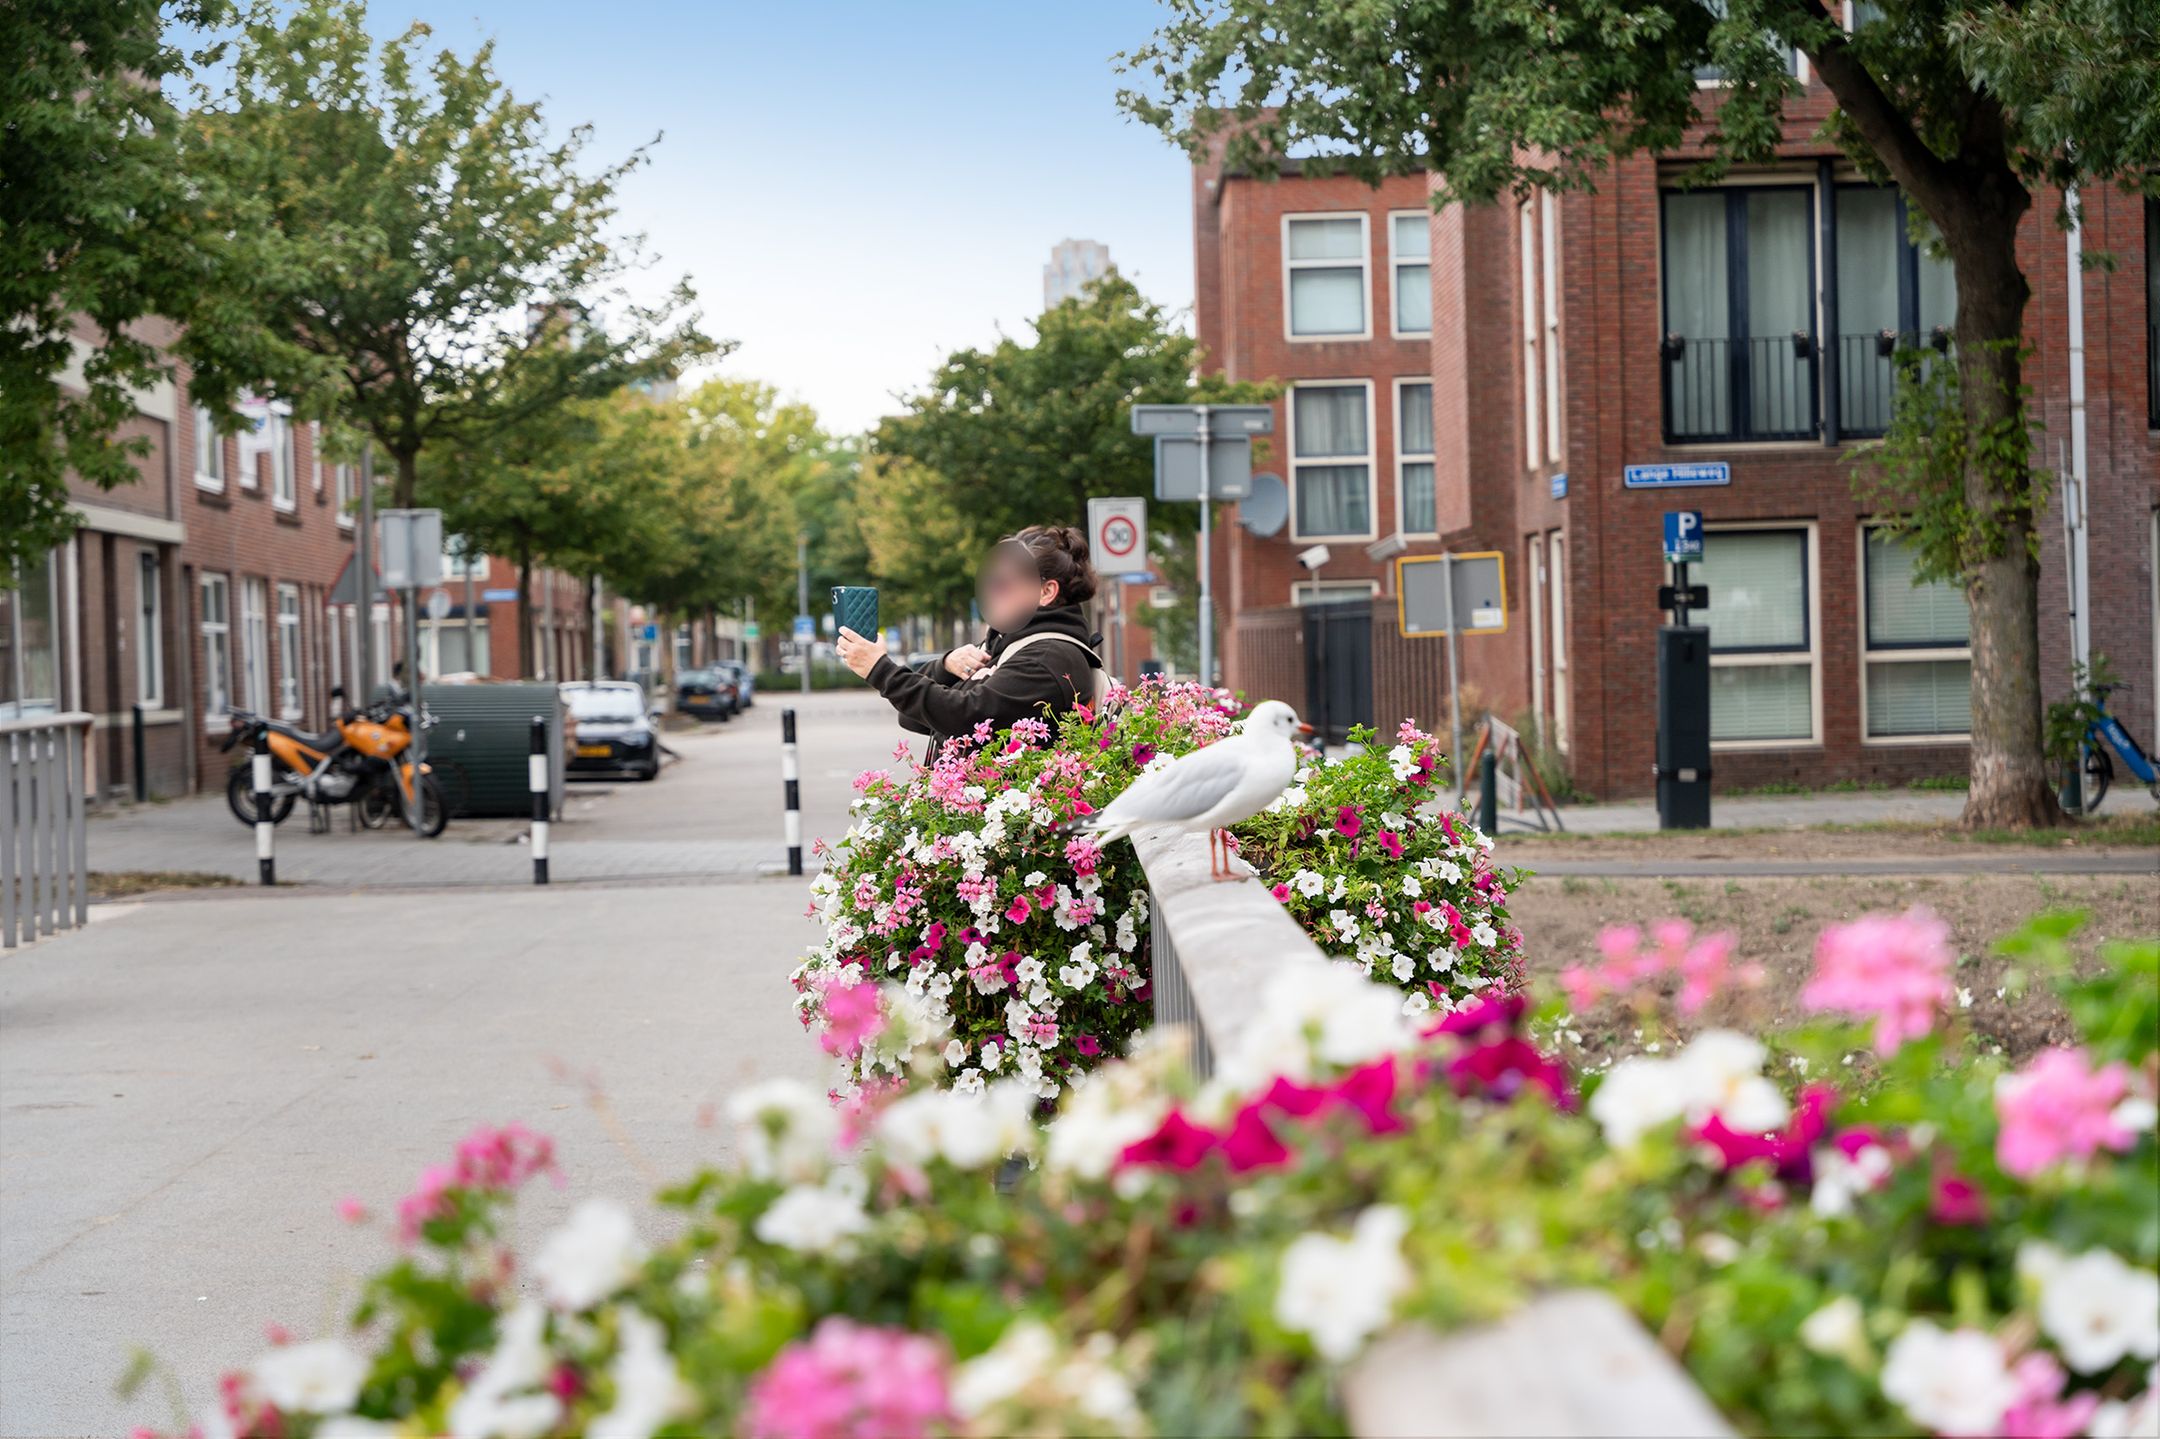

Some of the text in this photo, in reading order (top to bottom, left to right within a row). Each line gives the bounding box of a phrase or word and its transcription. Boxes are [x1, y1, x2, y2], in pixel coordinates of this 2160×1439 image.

[1632, 468, 1668, 482] Lange
[1678, 512, 1697, 538] P
[1108, 527, 1130, 545] 30
